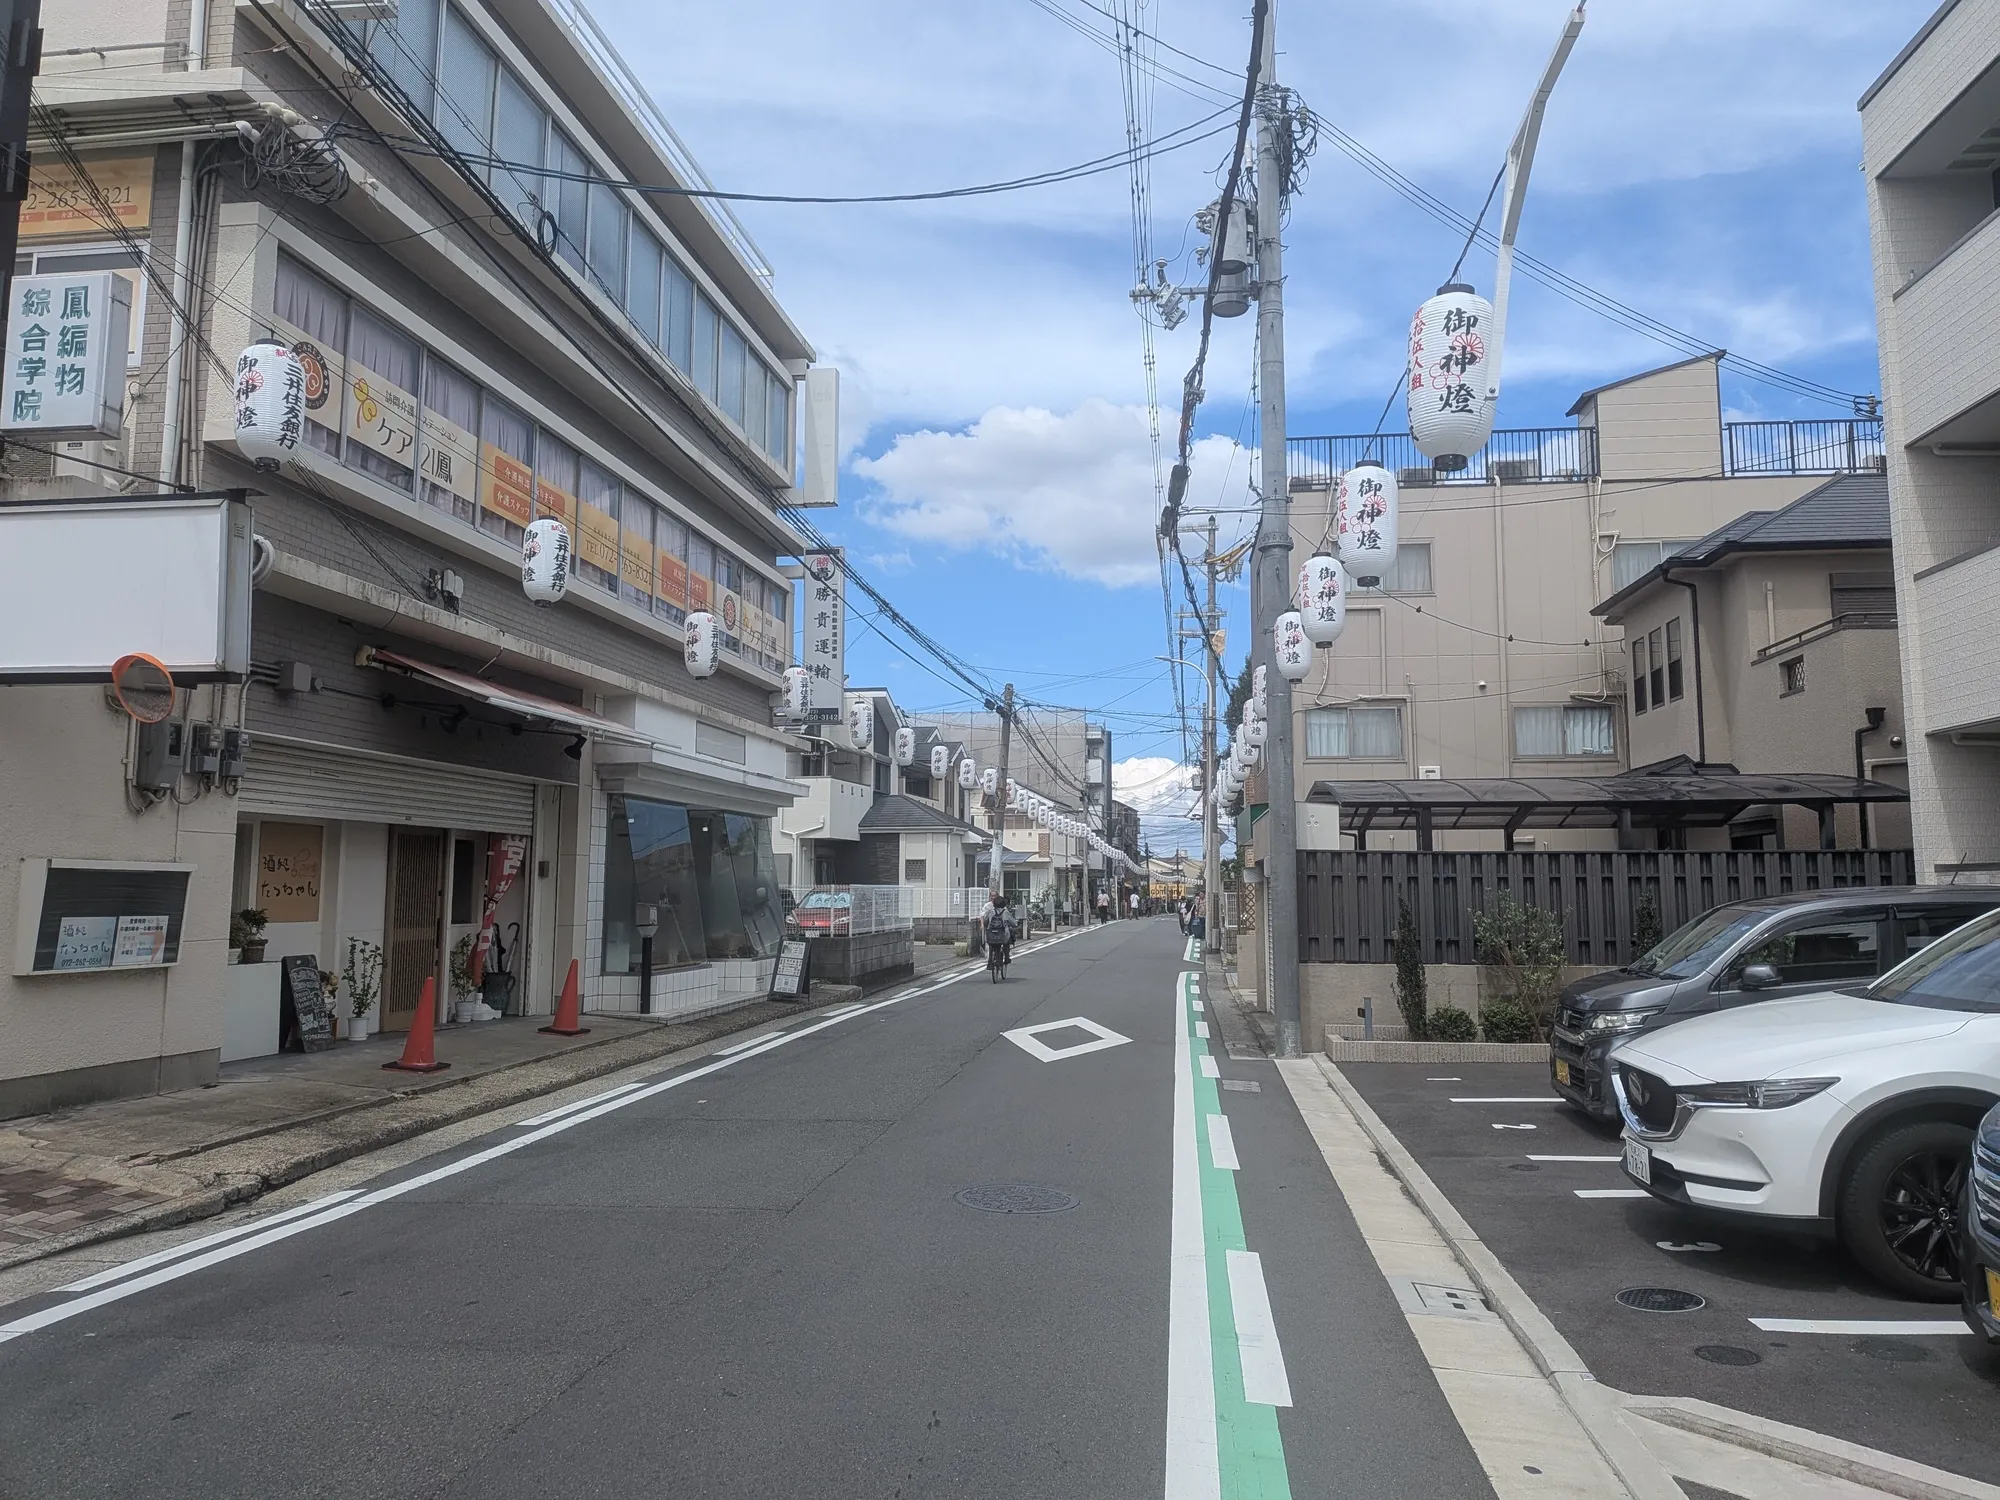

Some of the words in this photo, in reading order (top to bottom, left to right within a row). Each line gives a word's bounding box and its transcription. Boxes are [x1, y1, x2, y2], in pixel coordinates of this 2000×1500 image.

[11, 288, 52, 422] 綜合学院
[54, 285, 91, 396] 鳳編物
[1438, 307, 1479, 414] 御神燈
[236, 354, 262, 430] 御神燈
[275, 362, 305, 451] 三井住友銀行
[1357, 477, 1383, 551] 御神燈
[523, 528, 538, 583] 御神燈
[550, 533, 569, 593] 三井住友銀行
[1318, 566, 1337, 623] 御神燈
[686, 621, 699, 664] 御神燈
[709, 624, 718, 672] 三井住友銀行
[814, 585, 832, 679] 勝貴運輸
[1284, 620, 1301, 665] 御神燈
[783, 674, 792, 710] 御神燈
[60, 941, 111, 956] たっちゃん
